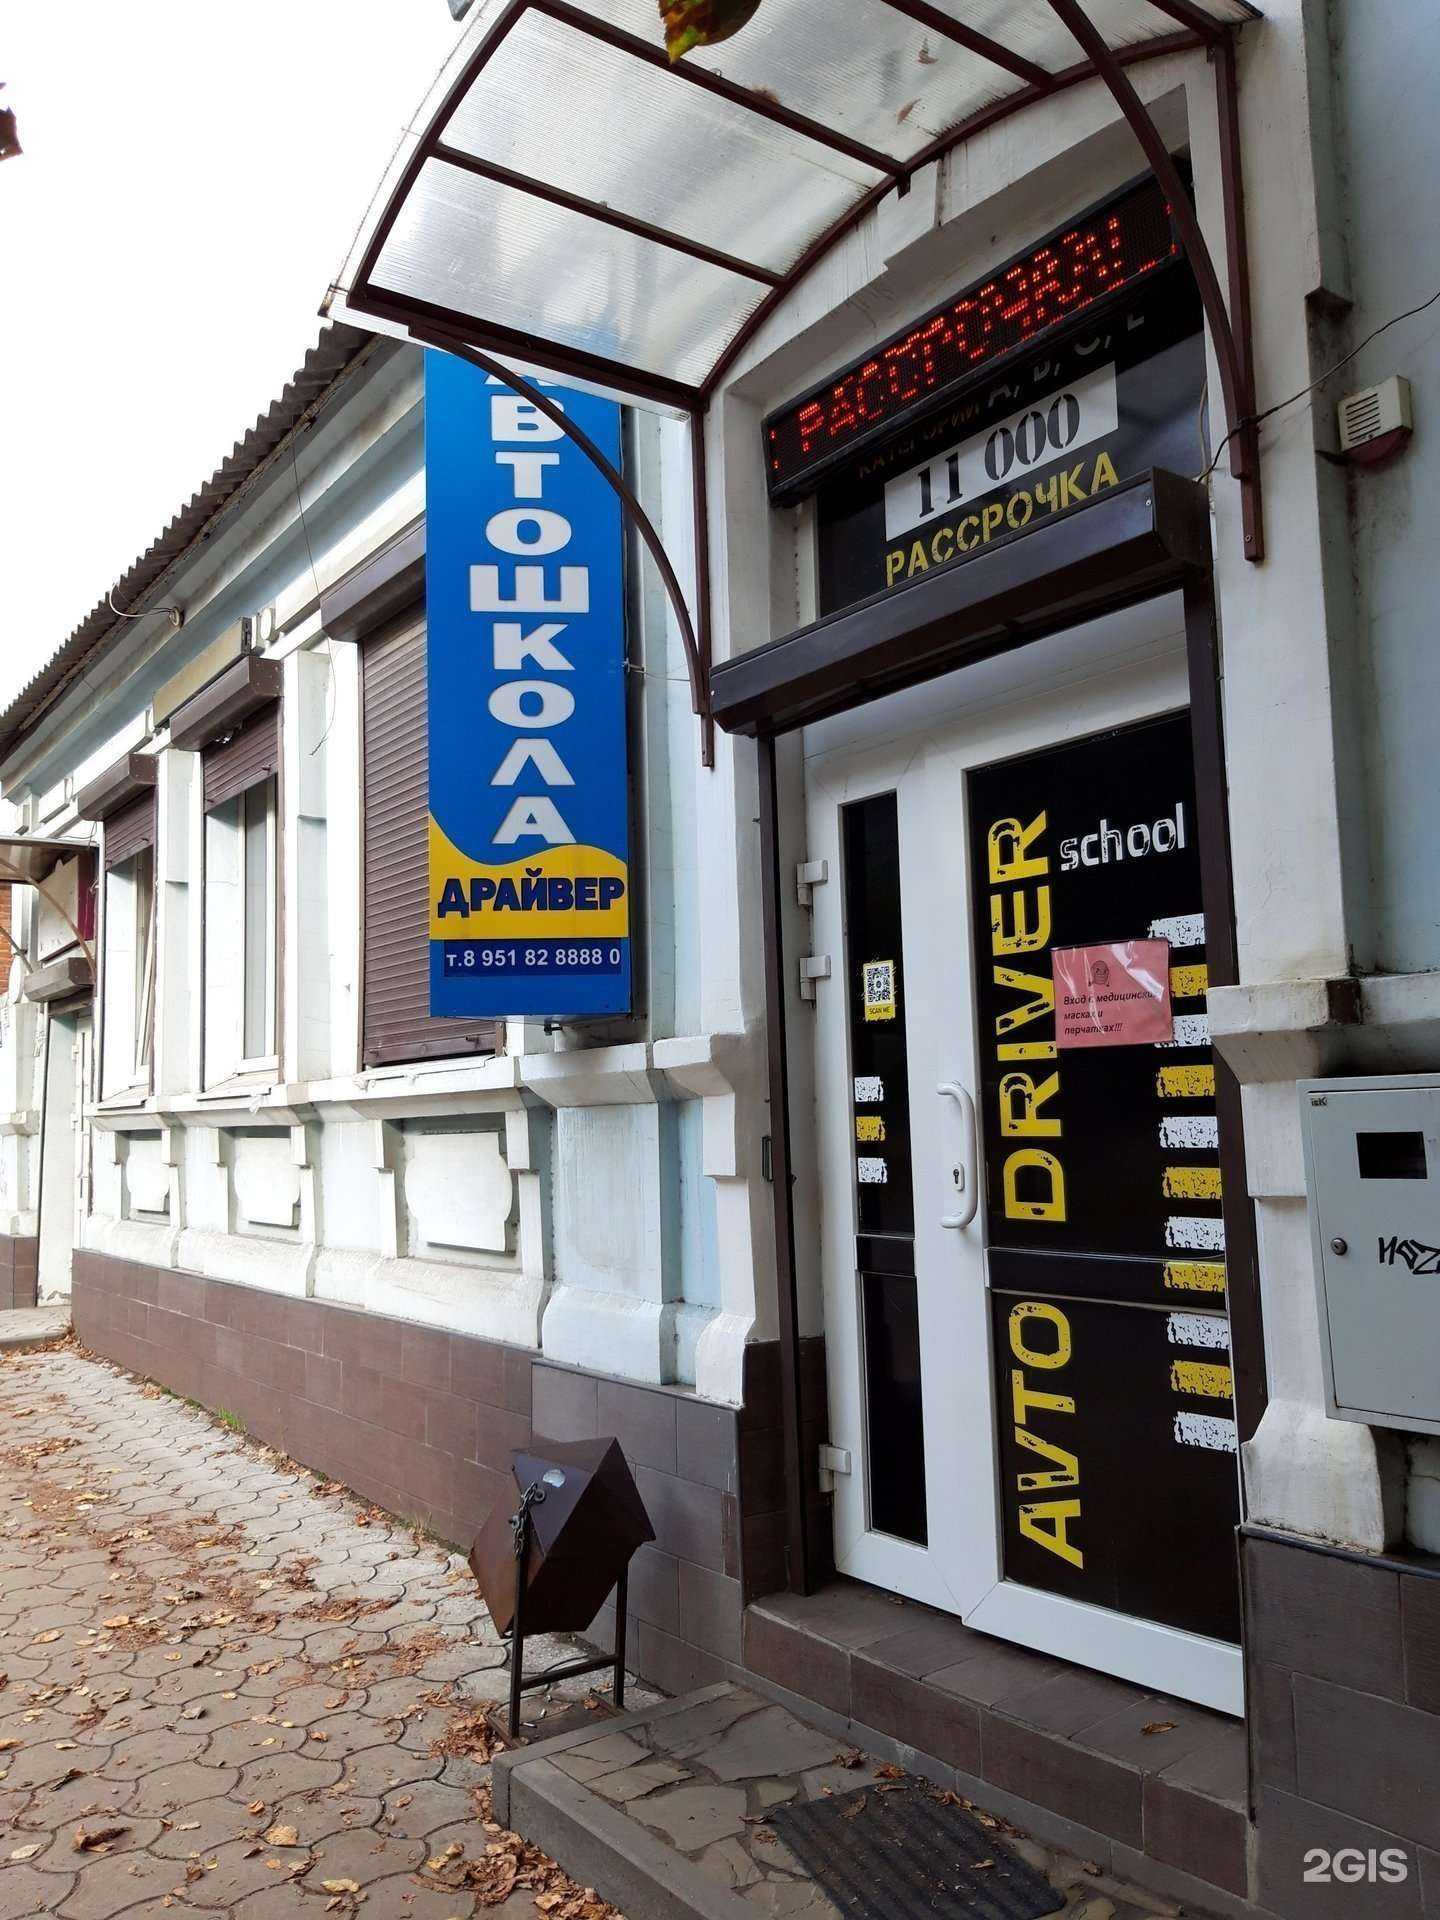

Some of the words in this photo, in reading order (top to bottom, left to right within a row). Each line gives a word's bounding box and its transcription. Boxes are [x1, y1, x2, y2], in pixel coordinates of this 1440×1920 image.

[917, 451, 963, 518] 11
[984, 393, 1080, 482] 000
[886, 451, 1120, 588] РАССРОЧКА
[1060, 802, 1185, 871] school
[437, 867, 625, 918] ДРАЙВЕР
[481, 949, 516, 966] 951
[524, 949, 549, 966] 82
[555, 948, 603, 965] 8888
[609, 948, 621, 965] 0
[869, 1007, 882, 1015] SCAN
[988, 809, 1067, 1222] DRIVER
[1063, 995, 1087, 1005] Вход
[1096, 991, 1156, 1003] медицински
[1098, 1010, 1103, 1018] и
[1008, 1301, 1084, 1570] AVTO
